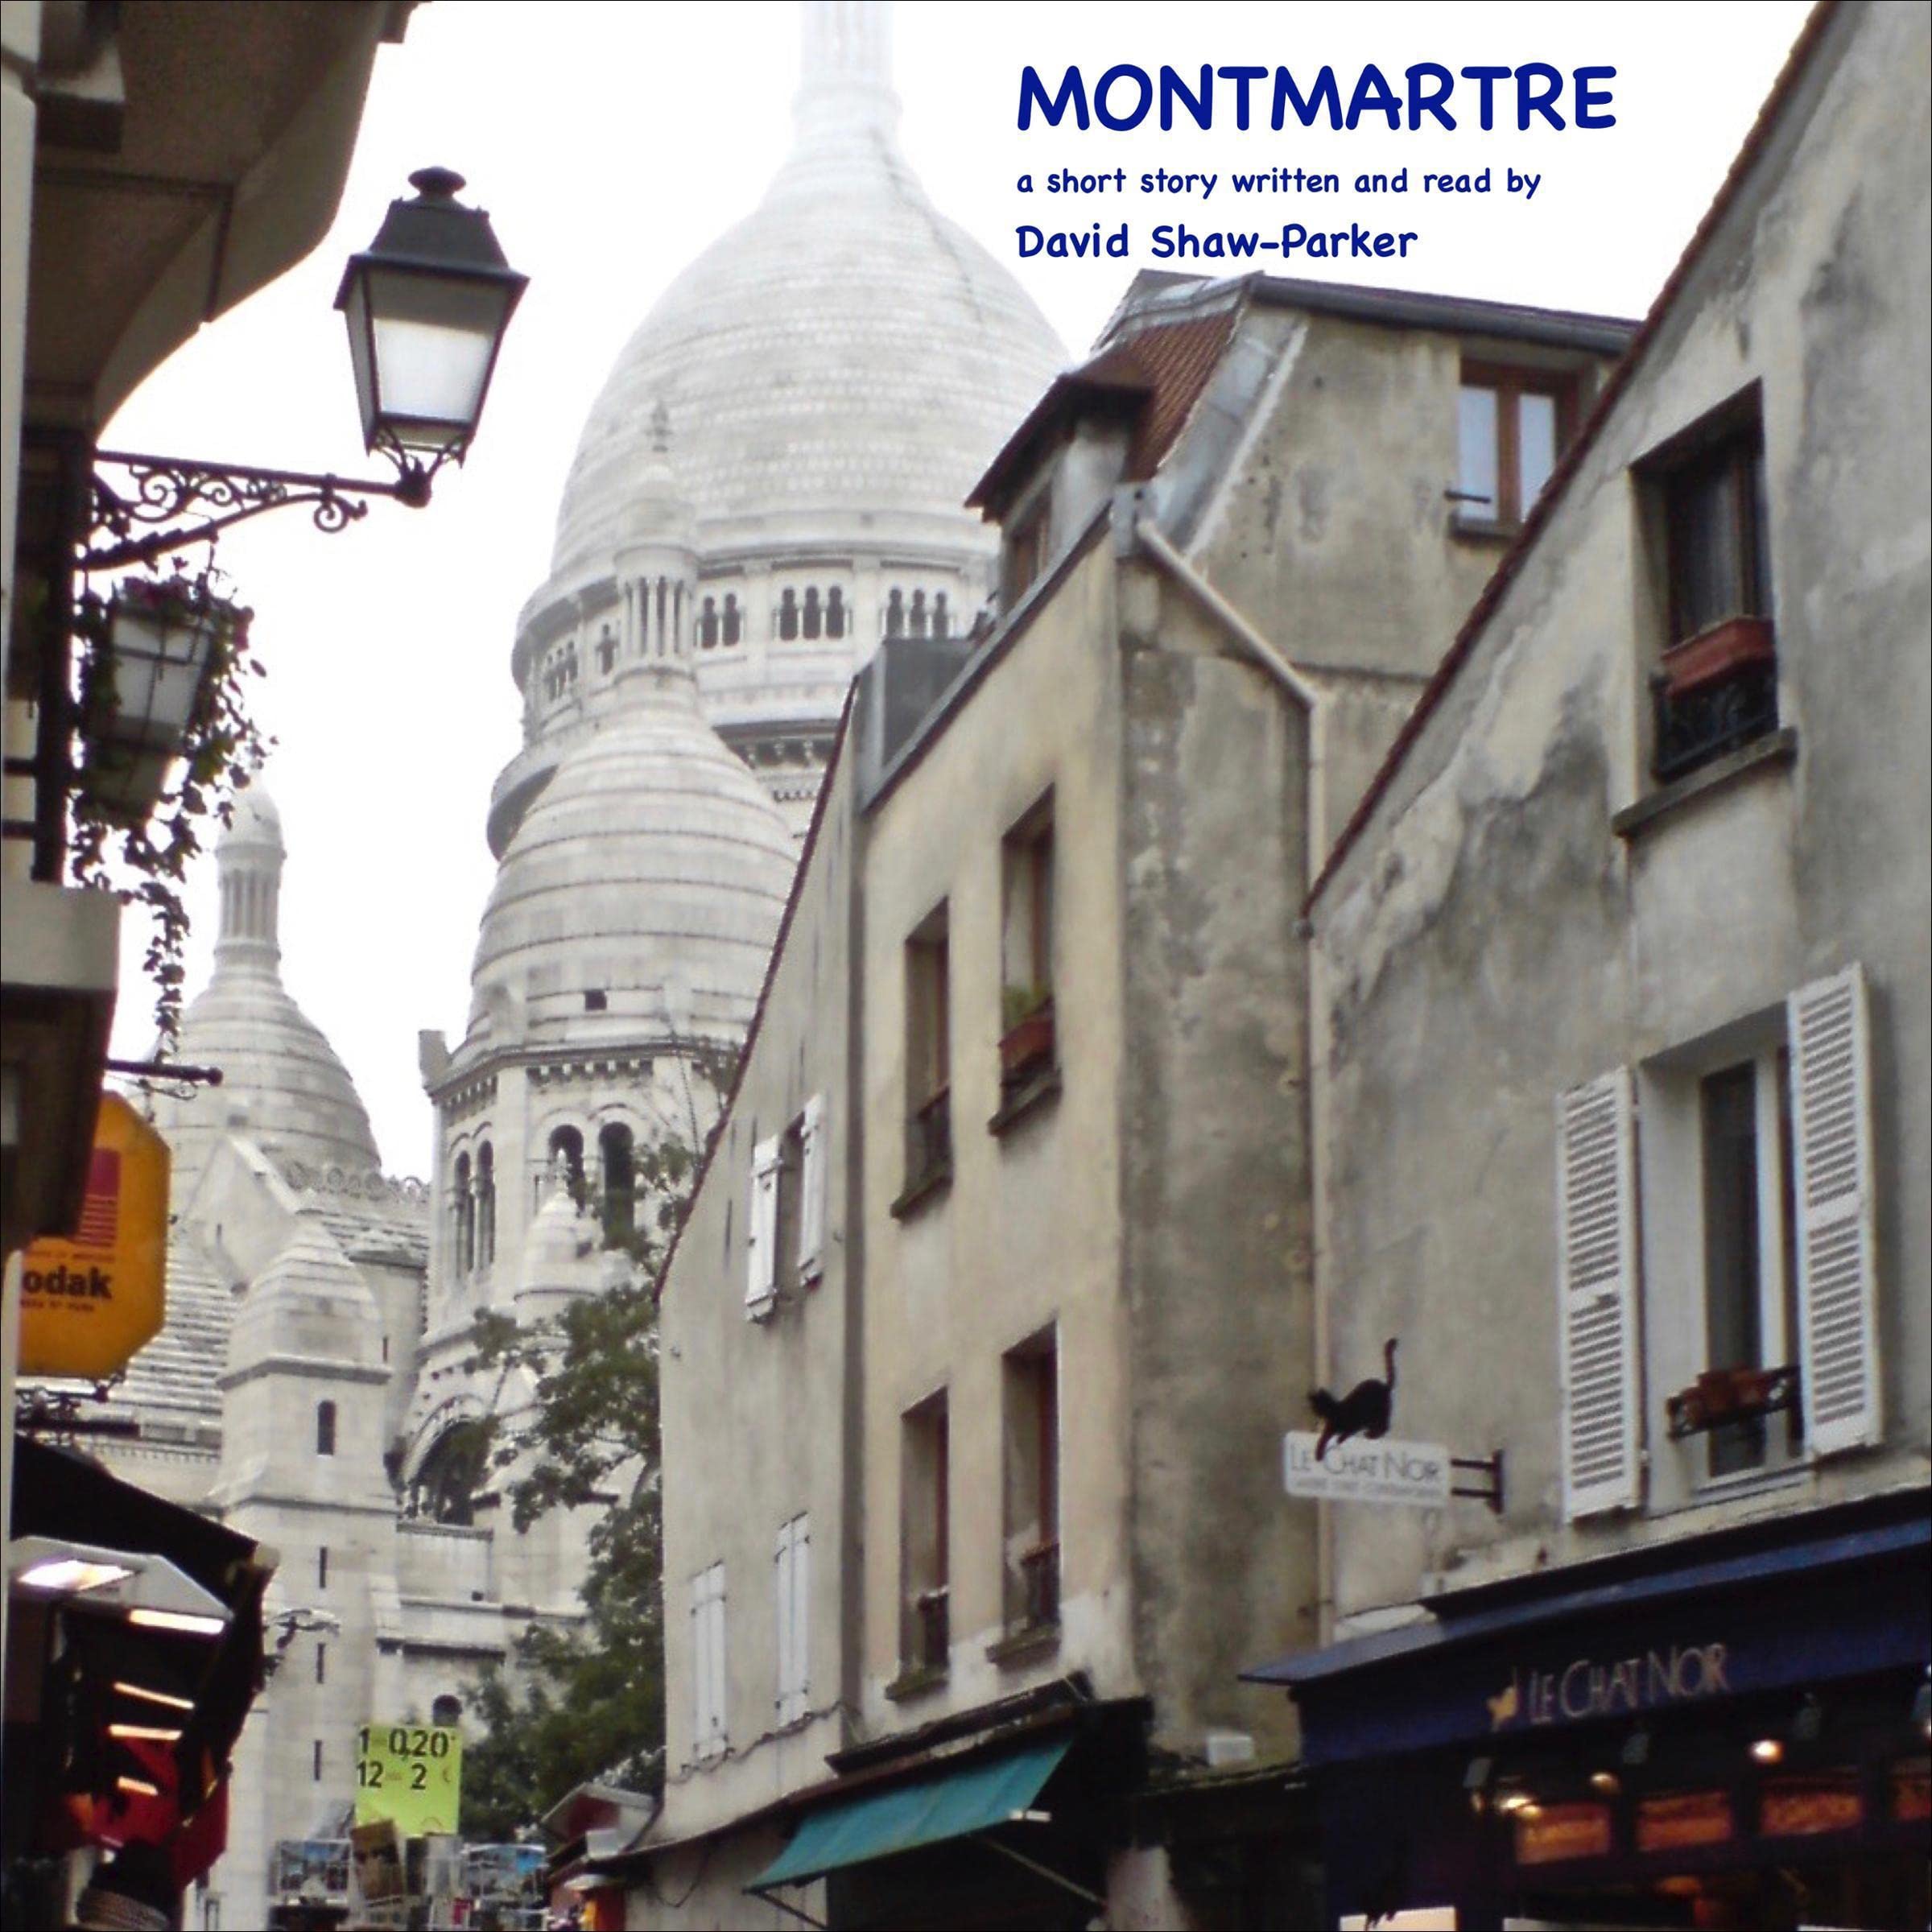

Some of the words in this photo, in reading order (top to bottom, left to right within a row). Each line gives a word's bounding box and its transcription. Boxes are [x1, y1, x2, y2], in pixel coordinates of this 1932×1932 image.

[1290, 1445, 1311, 1472] LE
[1530, 1670, 1554, 1724] LE
[1560, 1658, 1641, 1719] CHAT
[359, 1728, 370, 1755] 1
[357, 1761, 384, 1789] 12
[411, 1762, 427, 1790] 2
